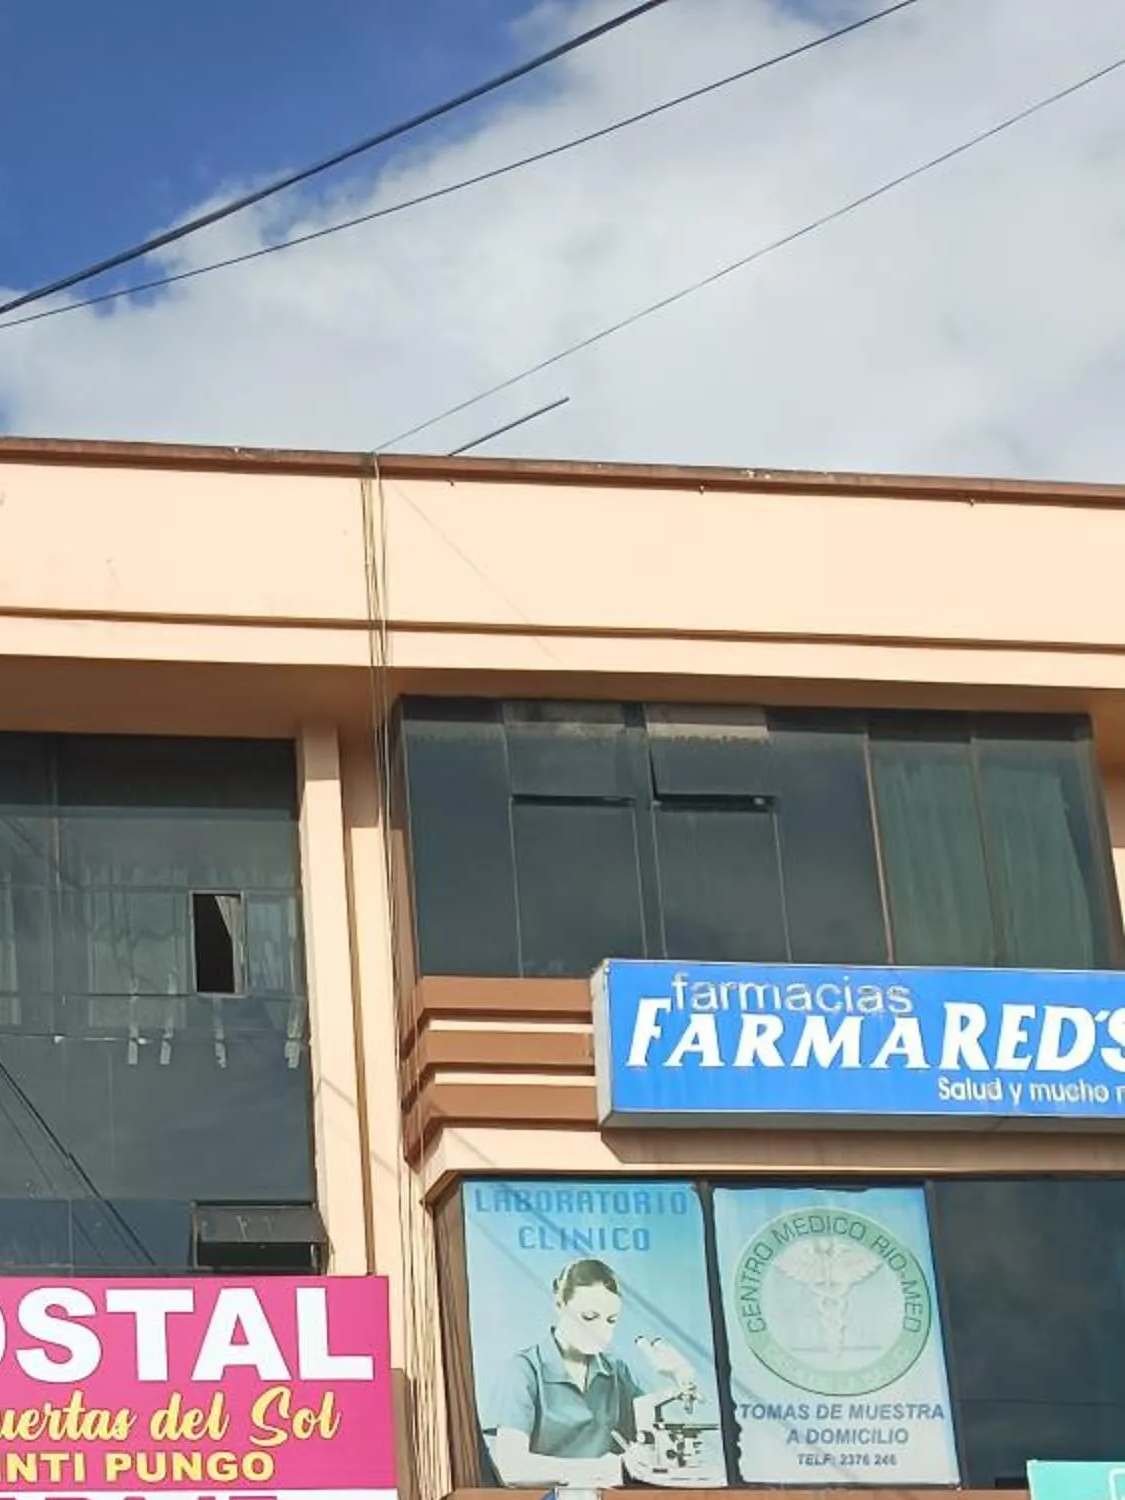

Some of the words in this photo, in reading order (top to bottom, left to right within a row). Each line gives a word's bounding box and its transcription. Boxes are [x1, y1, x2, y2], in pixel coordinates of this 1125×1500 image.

[672, 973, 914, 1014] farmacias
[939, 1075, 1002, 1101] Salud
[1008, 1083, 1023, 1106] y
[1030, 1079, 1109, 1104] mucho
[474, 1188, 688, 1216] LABORATORIO
[519, 1226, 650, 1251] CLINICO
[740, 1240, 775, 1335] CENTRO
[771, 1215, 867, 1246] MEDICO
[870, 1235, 924, 1334] RIO-MED
[150, 1391, 230, 1443] del
[250, 1386, 341, 1448] Sol
[739, 1404, 811, 1420] TOMAS
[816, 1404, 844, 1420] DE
[848, 1404, 945, 1420] MUESTRA
[786, 1428, 800, 1444] A
[806, 1428, 909, 1445] DOMICILIO
[104, 1450, 276, 1482] PUNGO
